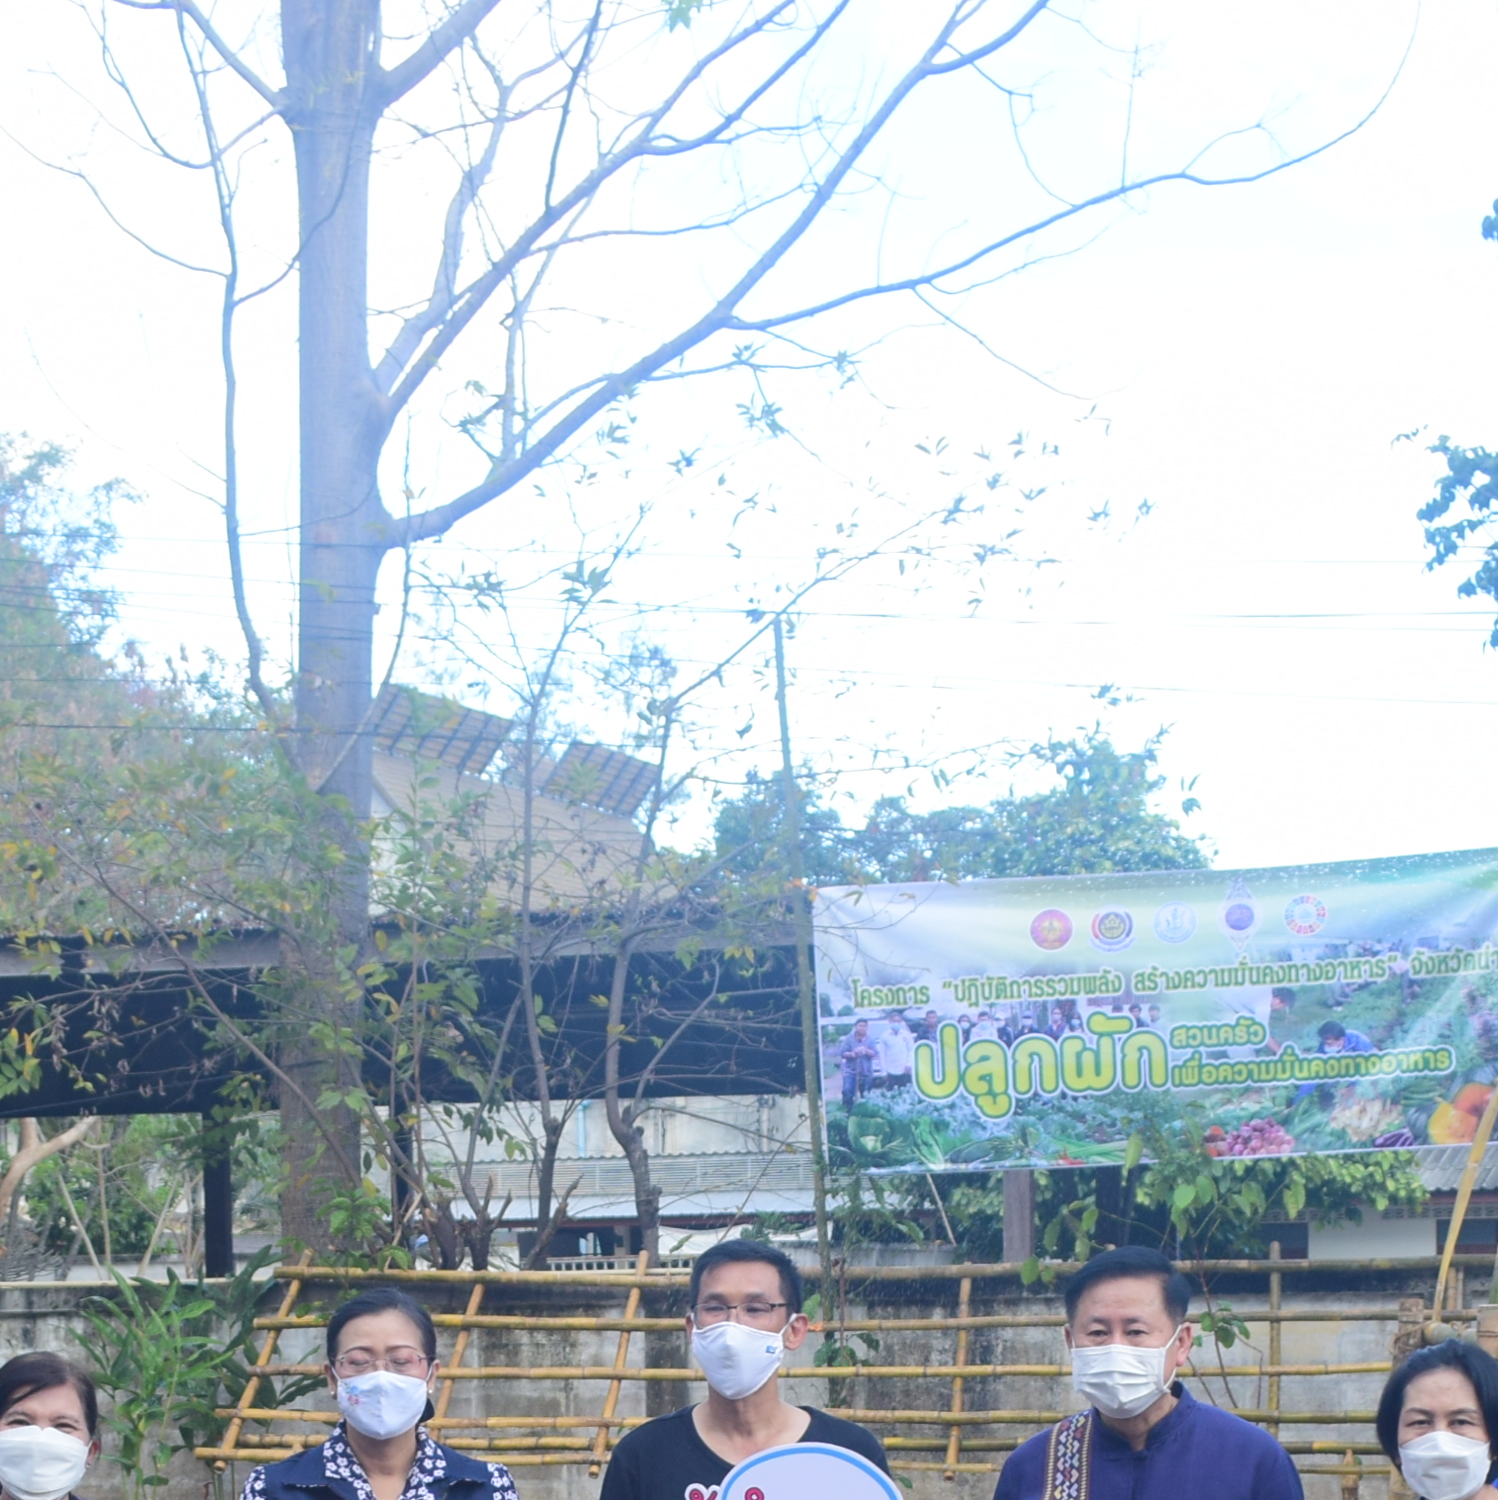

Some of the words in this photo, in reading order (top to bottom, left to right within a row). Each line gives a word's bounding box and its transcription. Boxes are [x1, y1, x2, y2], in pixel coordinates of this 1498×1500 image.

[851, 978, 930, 1008] โครงการ
[1171, 1017, 1267, 1050] สวนครัว
[916, 1011, 1169, 1118] ปลูกผัก
[1172, 1044, 1453, 1088] เพื่อความมั่นคงทางอาหาร
